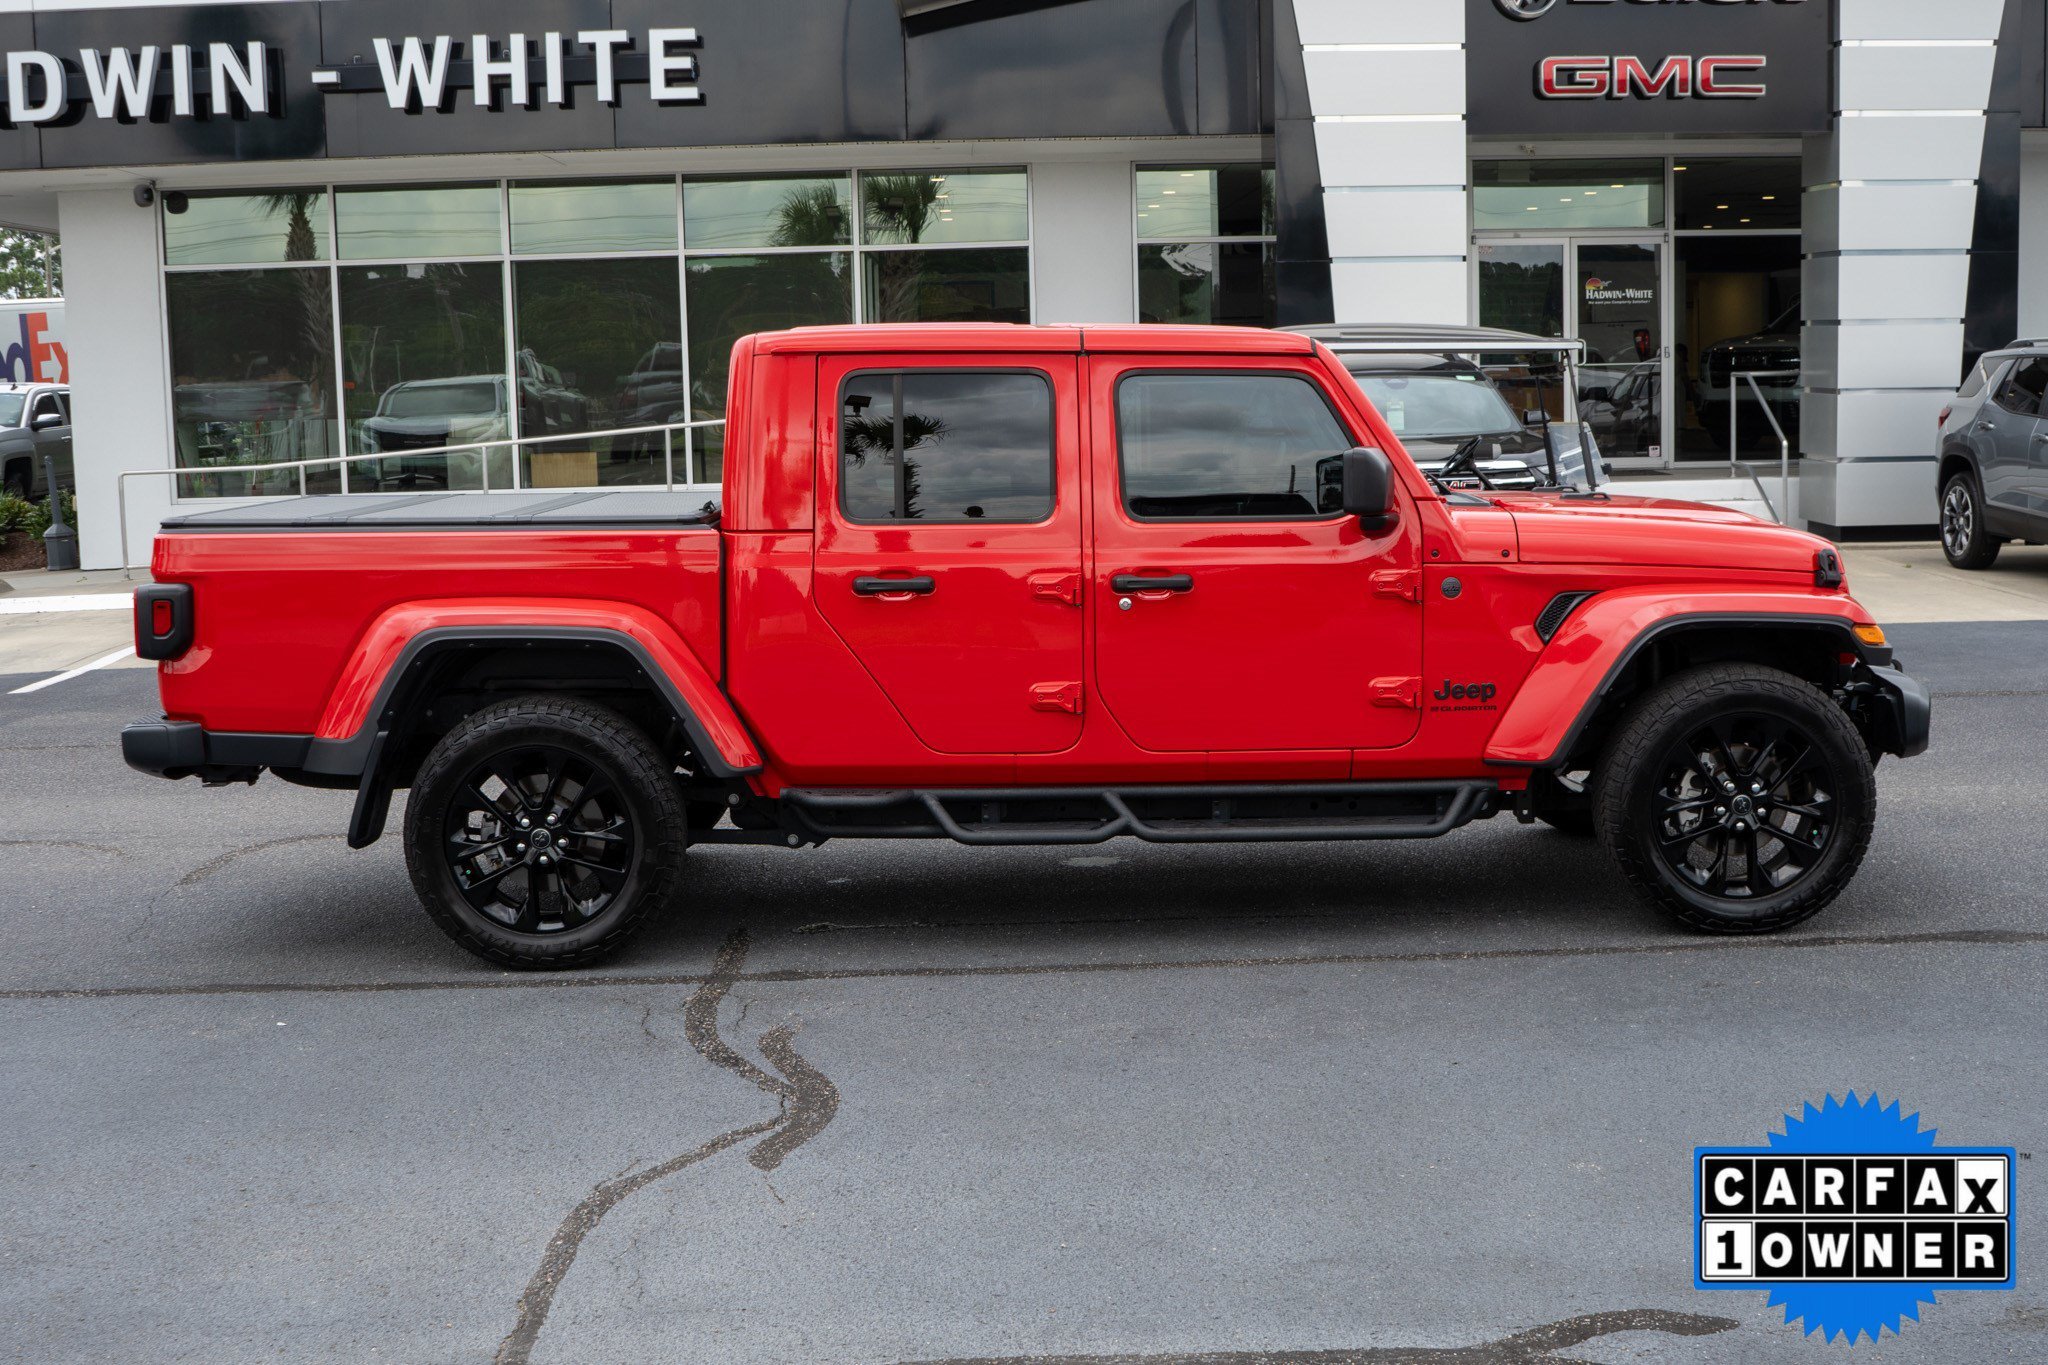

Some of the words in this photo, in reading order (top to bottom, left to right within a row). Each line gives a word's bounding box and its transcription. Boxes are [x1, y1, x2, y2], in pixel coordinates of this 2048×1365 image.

[7, 40, 270, 123] DWIN
[372, 28, 701, 109] WHITE
[1539, 55, 1767, 97] GMC
[1433, 679, 1496, 702] Jeep
